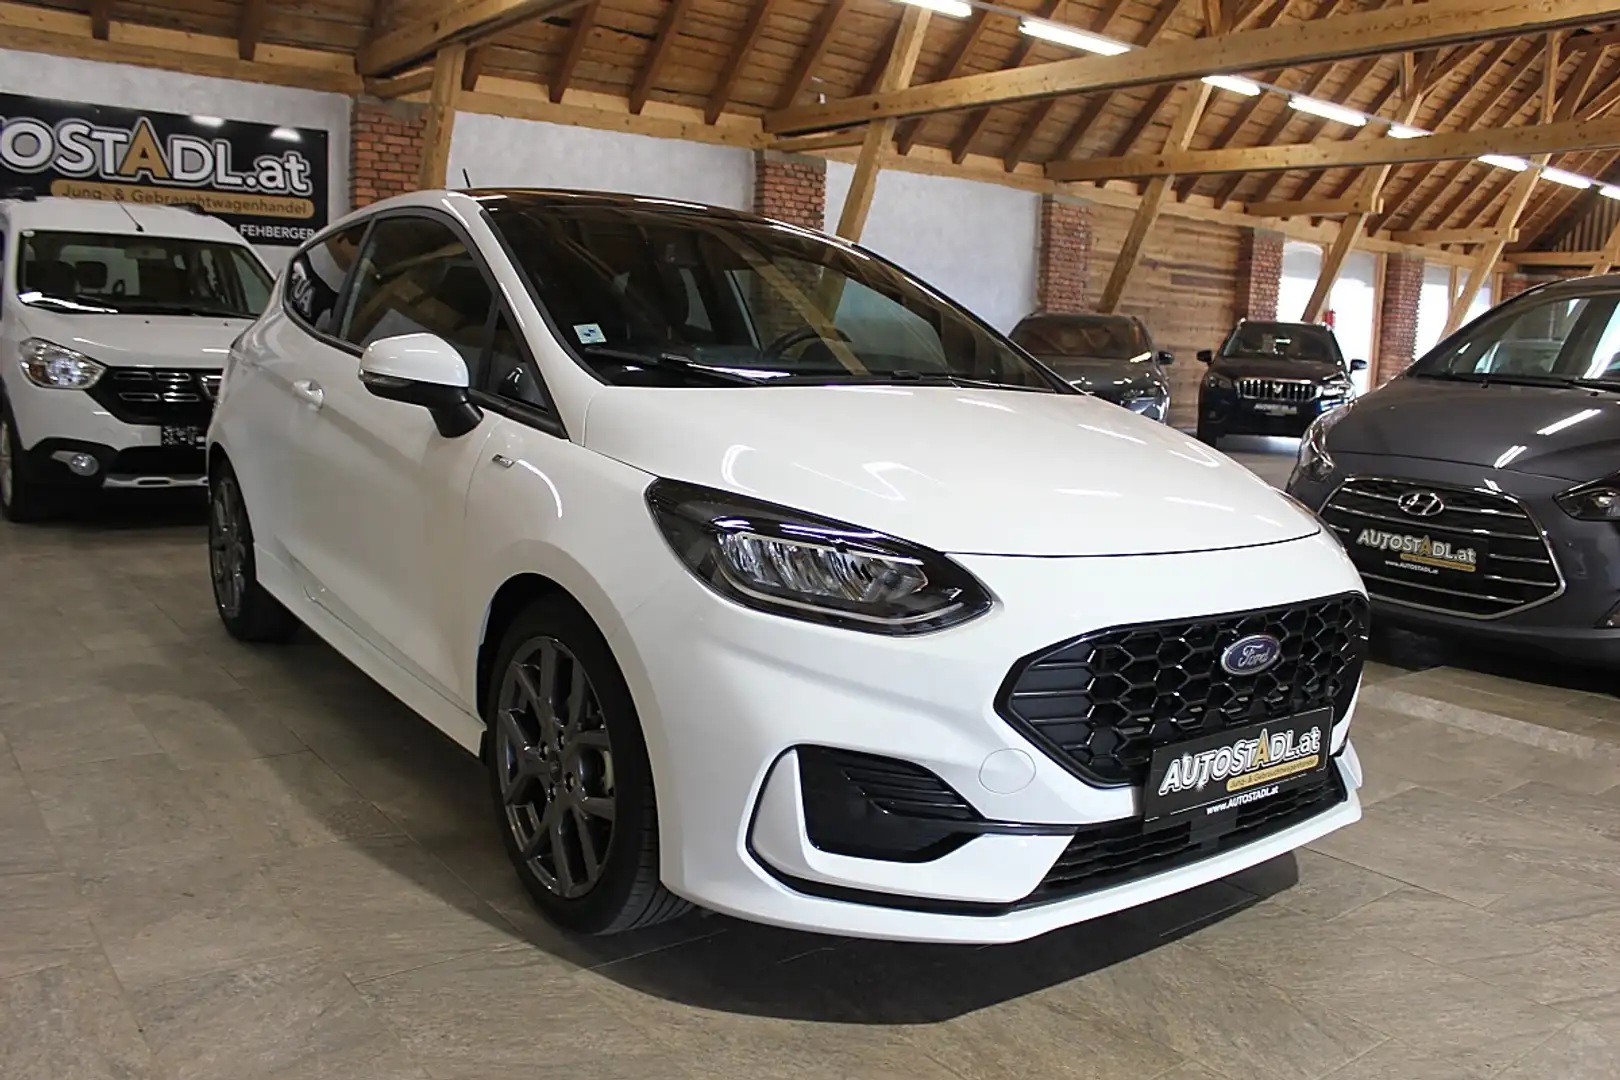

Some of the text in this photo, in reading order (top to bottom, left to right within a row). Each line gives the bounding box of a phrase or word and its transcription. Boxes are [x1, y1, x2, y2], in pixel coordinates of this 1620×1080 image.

[0, 117, 312, 195] OSTADL.at
[113, 188, 125, 201] &
[240, 224, 315, 239] FEHBERGER
[1356, 528, 1476, 563] AUTOSTADL.at
[1238, 644, 1271, 667] Ford
[1158, 727, 1321, 796] AUTOSTADL.at
[1206, 785, 1279, 815] www.AUTOSTADL.at
